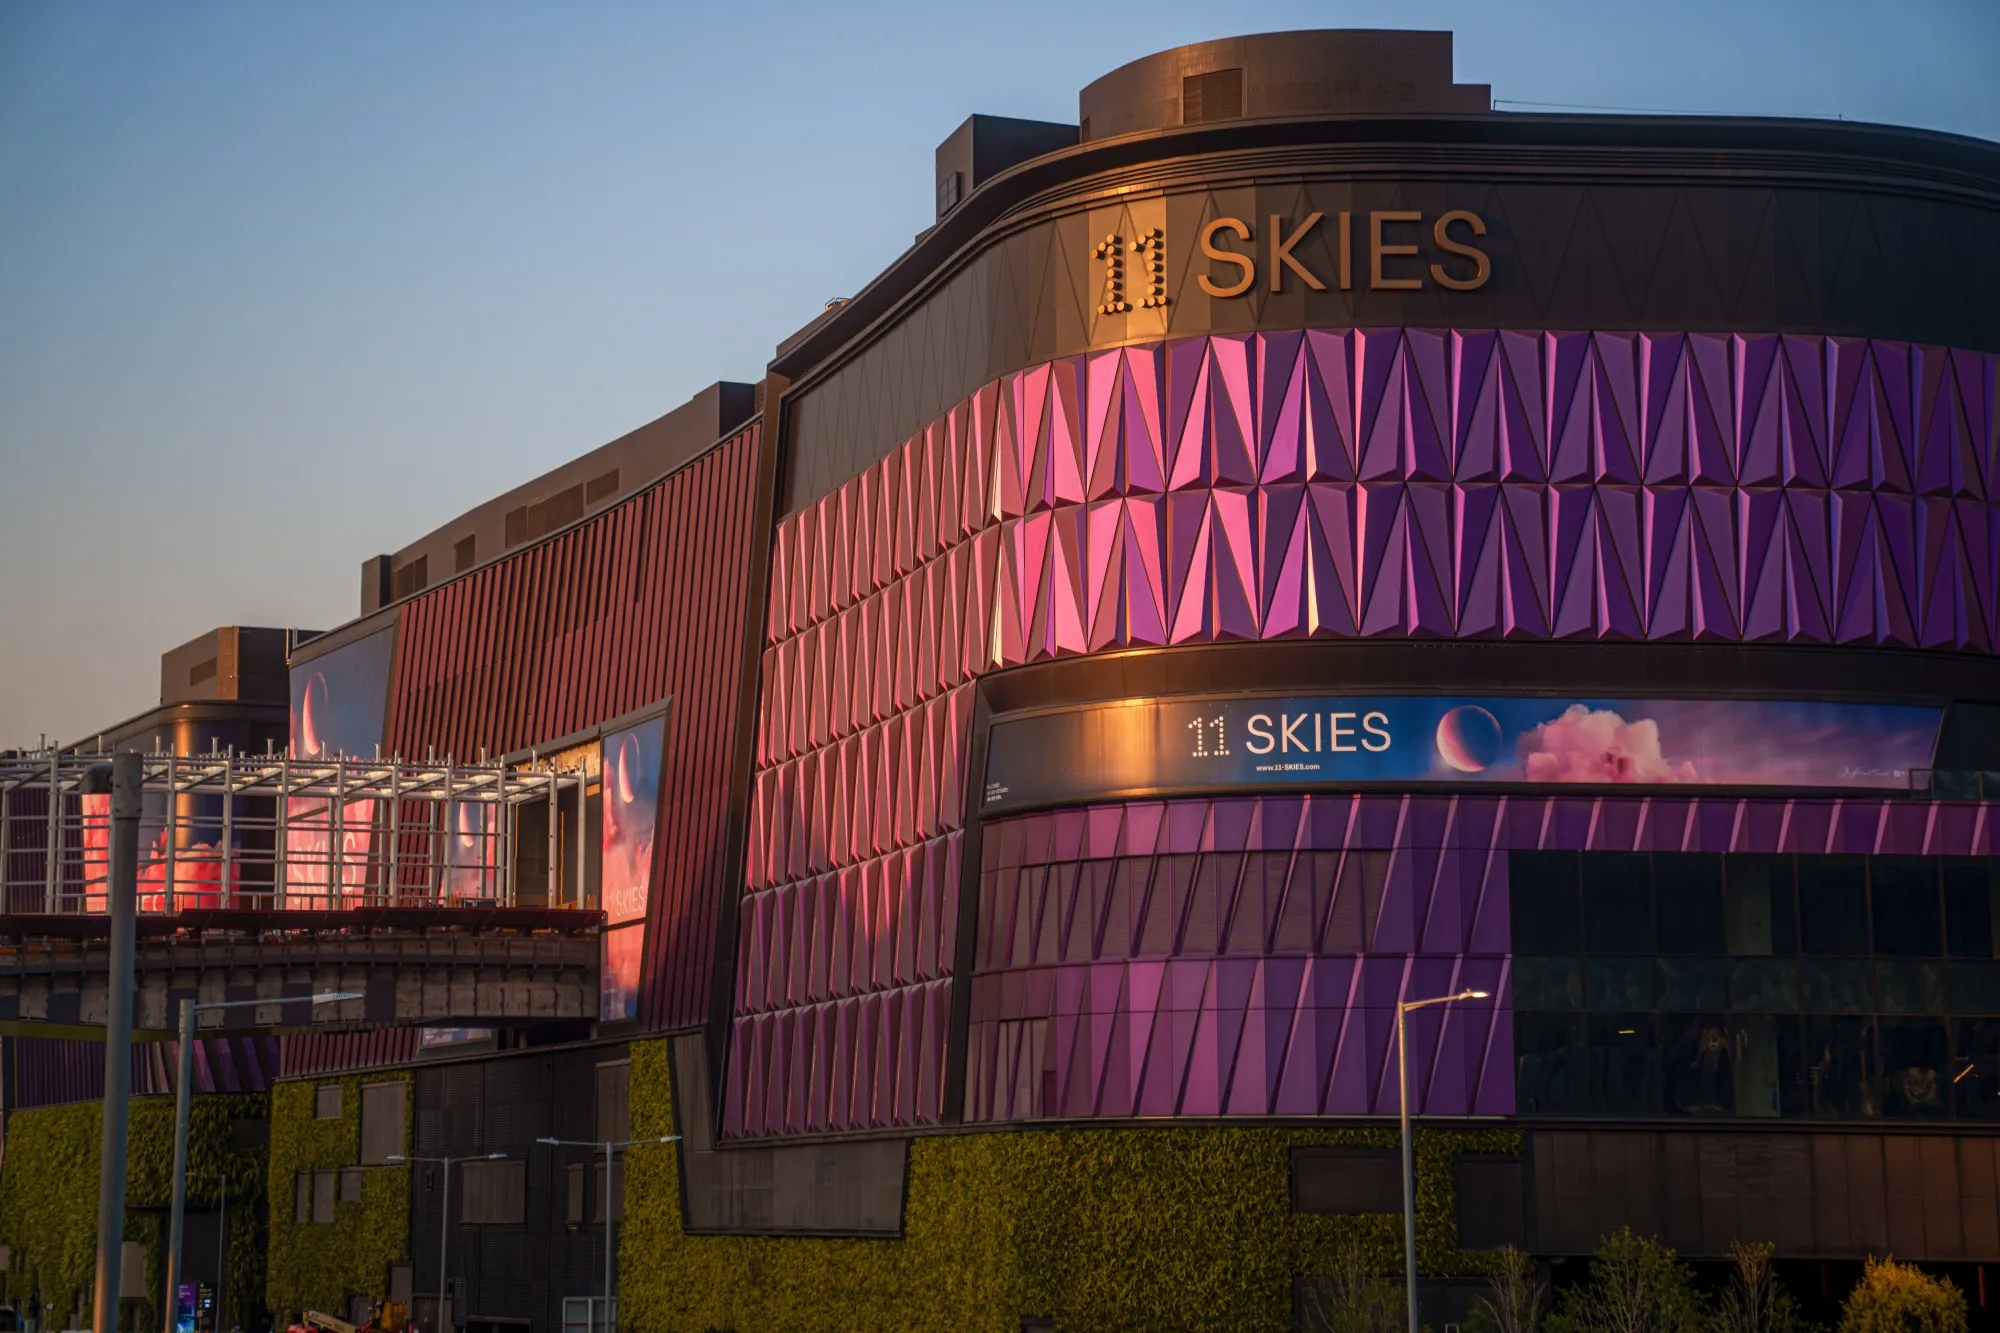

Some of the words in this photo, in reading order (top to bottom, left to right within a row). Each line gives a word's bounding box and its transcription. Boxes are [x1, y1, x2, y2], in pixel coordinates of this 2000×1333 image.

[1090, 227, 1169, 315] 11
[1197, 209, 1492, 298] SKIES
[1188, 715, 1230, 758] 11
[1245, 712, 1392, 755] SKIES
[1256, 763, 1320, 771] www.11-SKIES.com
[615, 885, 645, 916] SKIES
